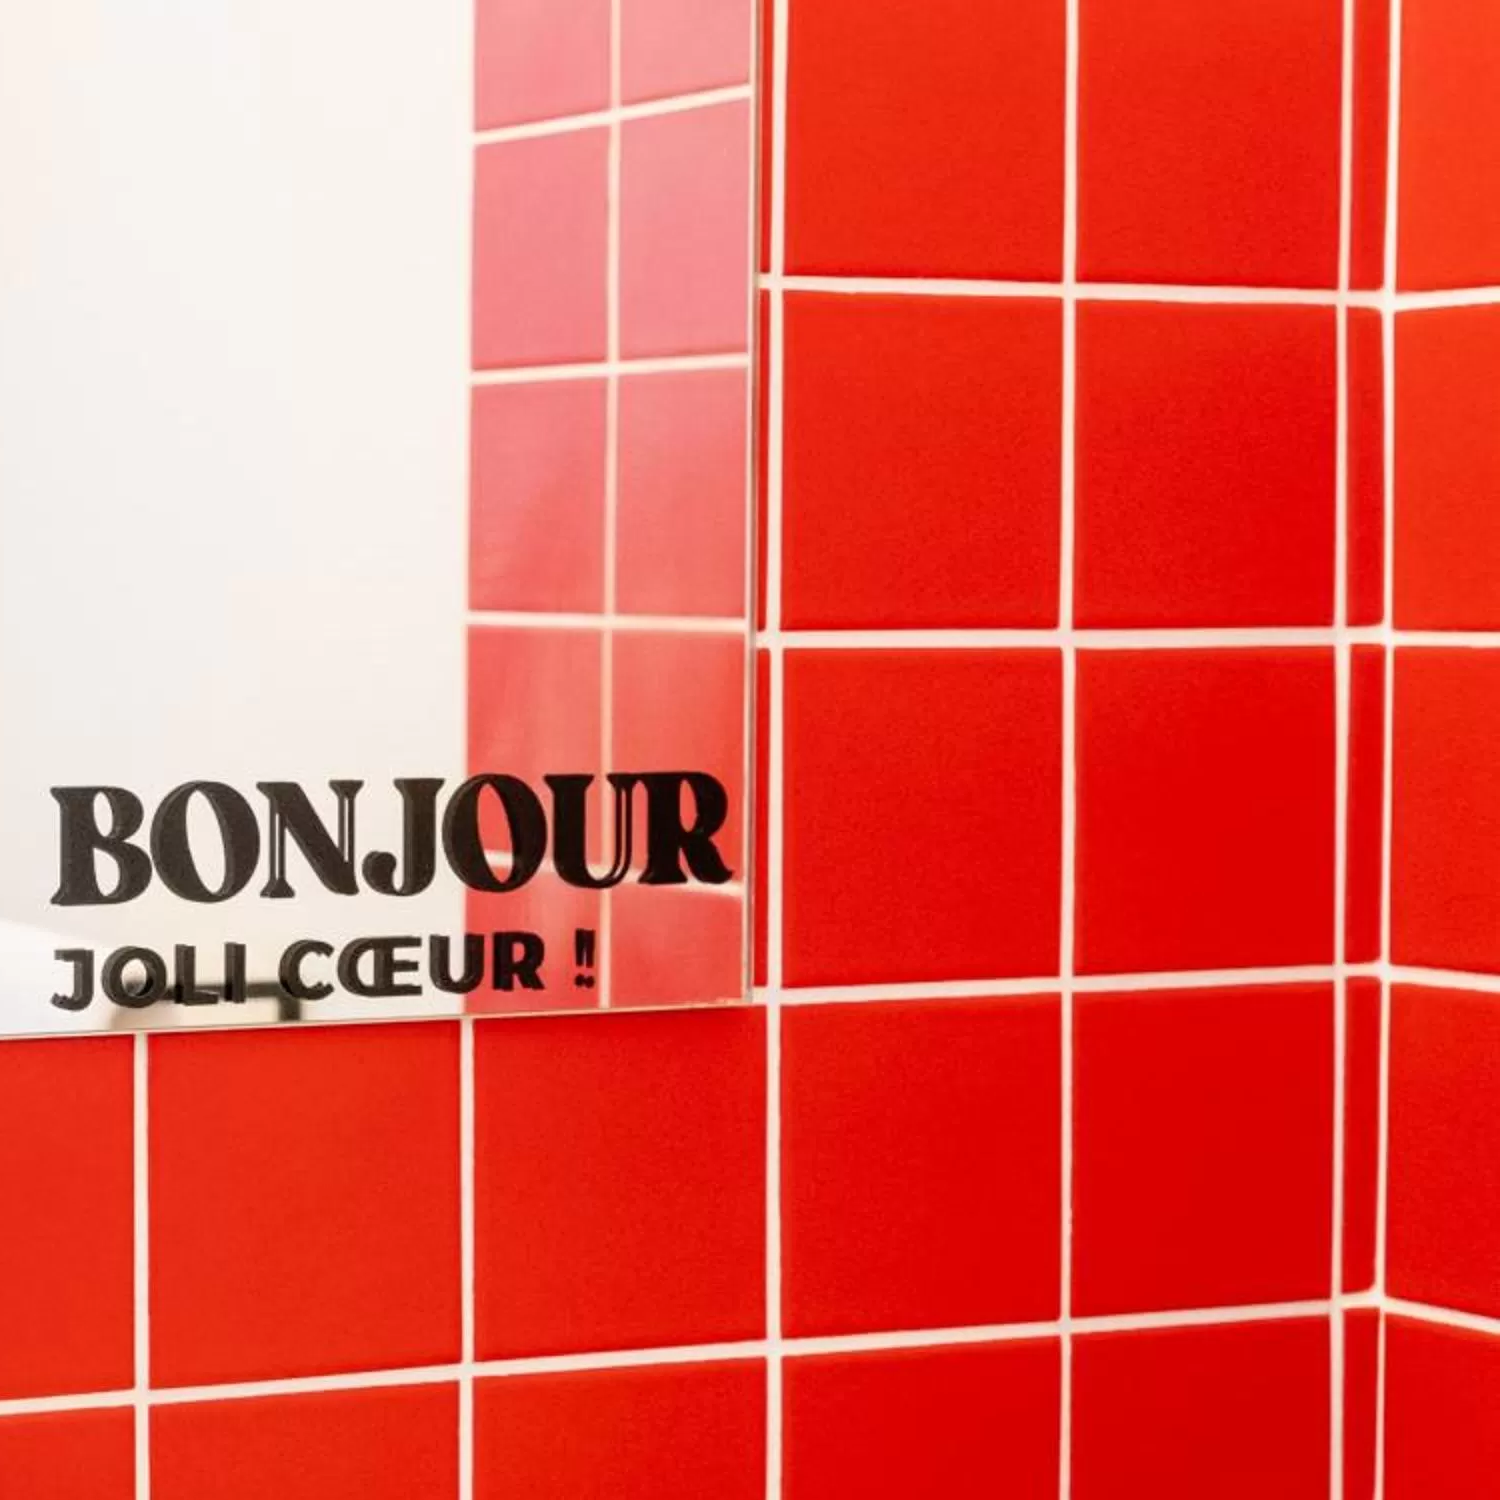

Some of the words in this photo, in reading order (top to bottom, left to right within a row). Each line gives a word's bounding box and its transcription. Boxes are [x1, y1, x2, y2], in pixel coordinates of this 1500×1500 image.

[50, 771, 735, 905] BONJOUR
[50, 942, 248, 1012] JOLI
[277, 931, 547, 1001] CŒUR
